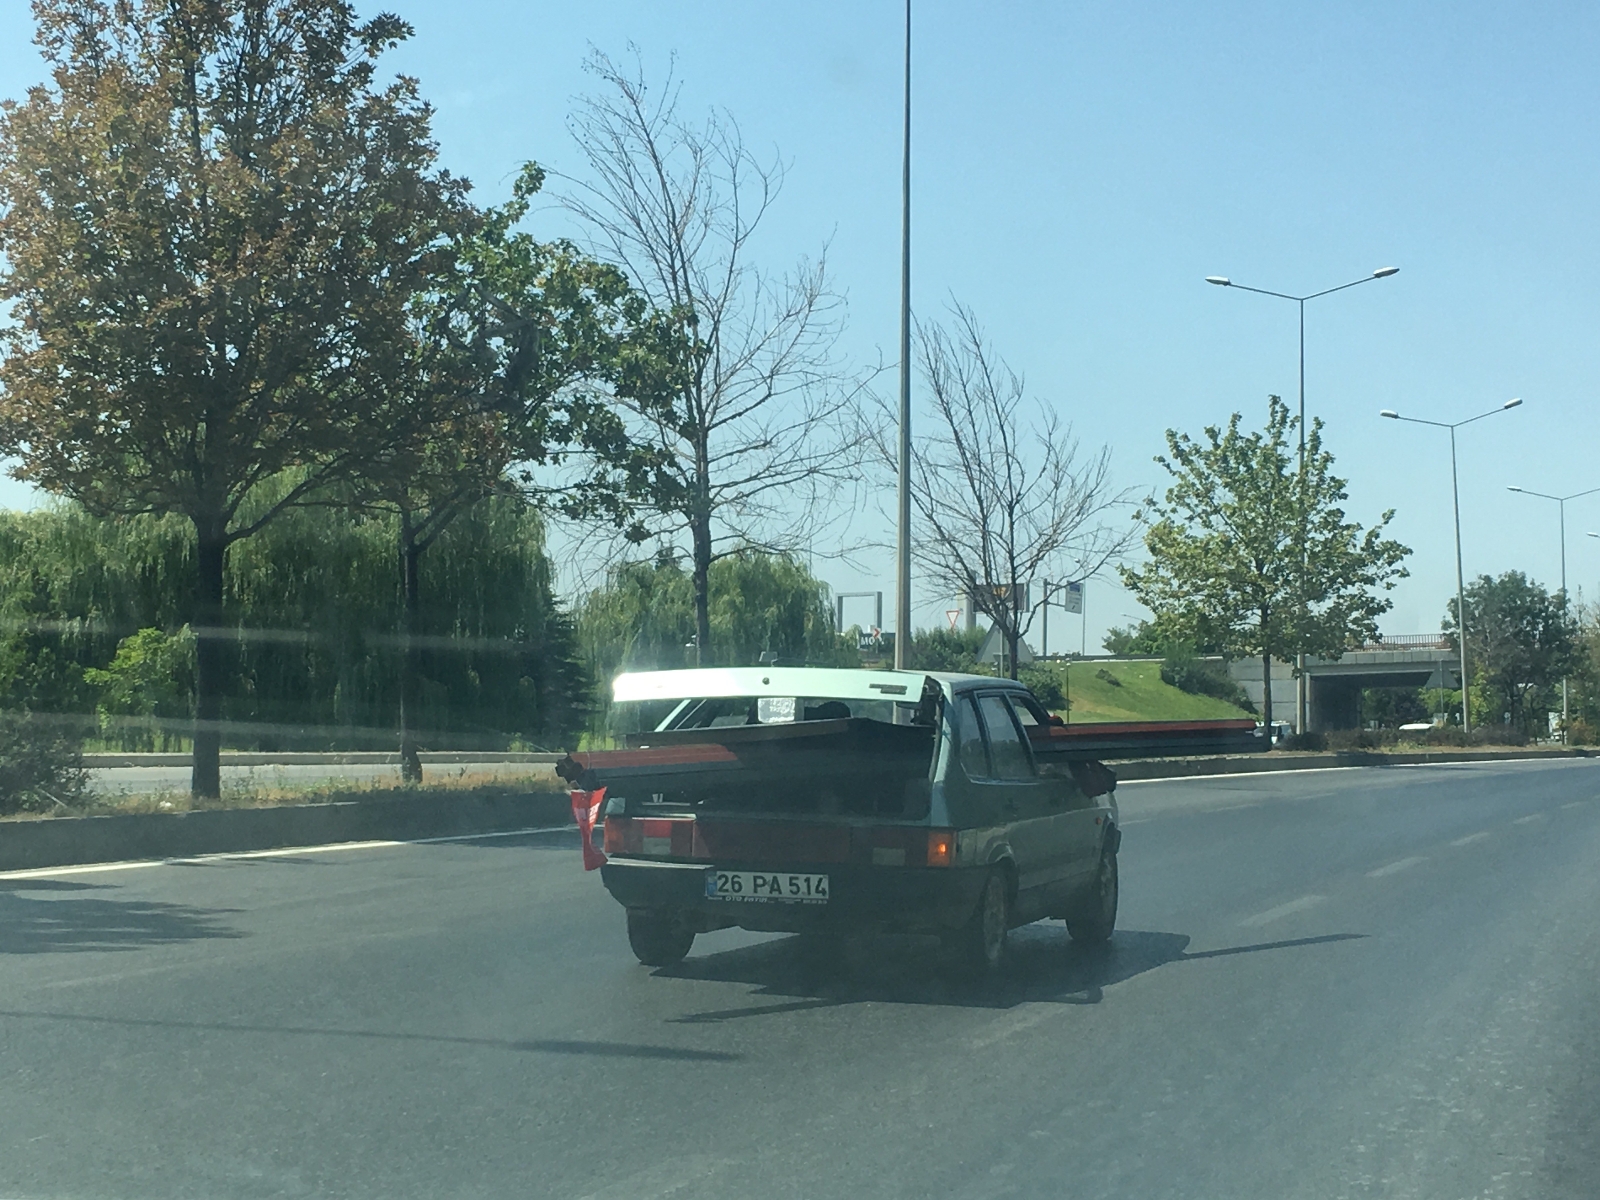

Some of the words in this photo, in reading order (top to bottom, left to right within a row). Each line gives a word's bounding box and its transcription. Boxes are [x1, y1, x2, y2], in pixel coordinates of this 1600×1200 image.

[717, 874, 743, 893] 26
[752, 875, 782, 895] PA
[788, 876, 827, 896] 514
